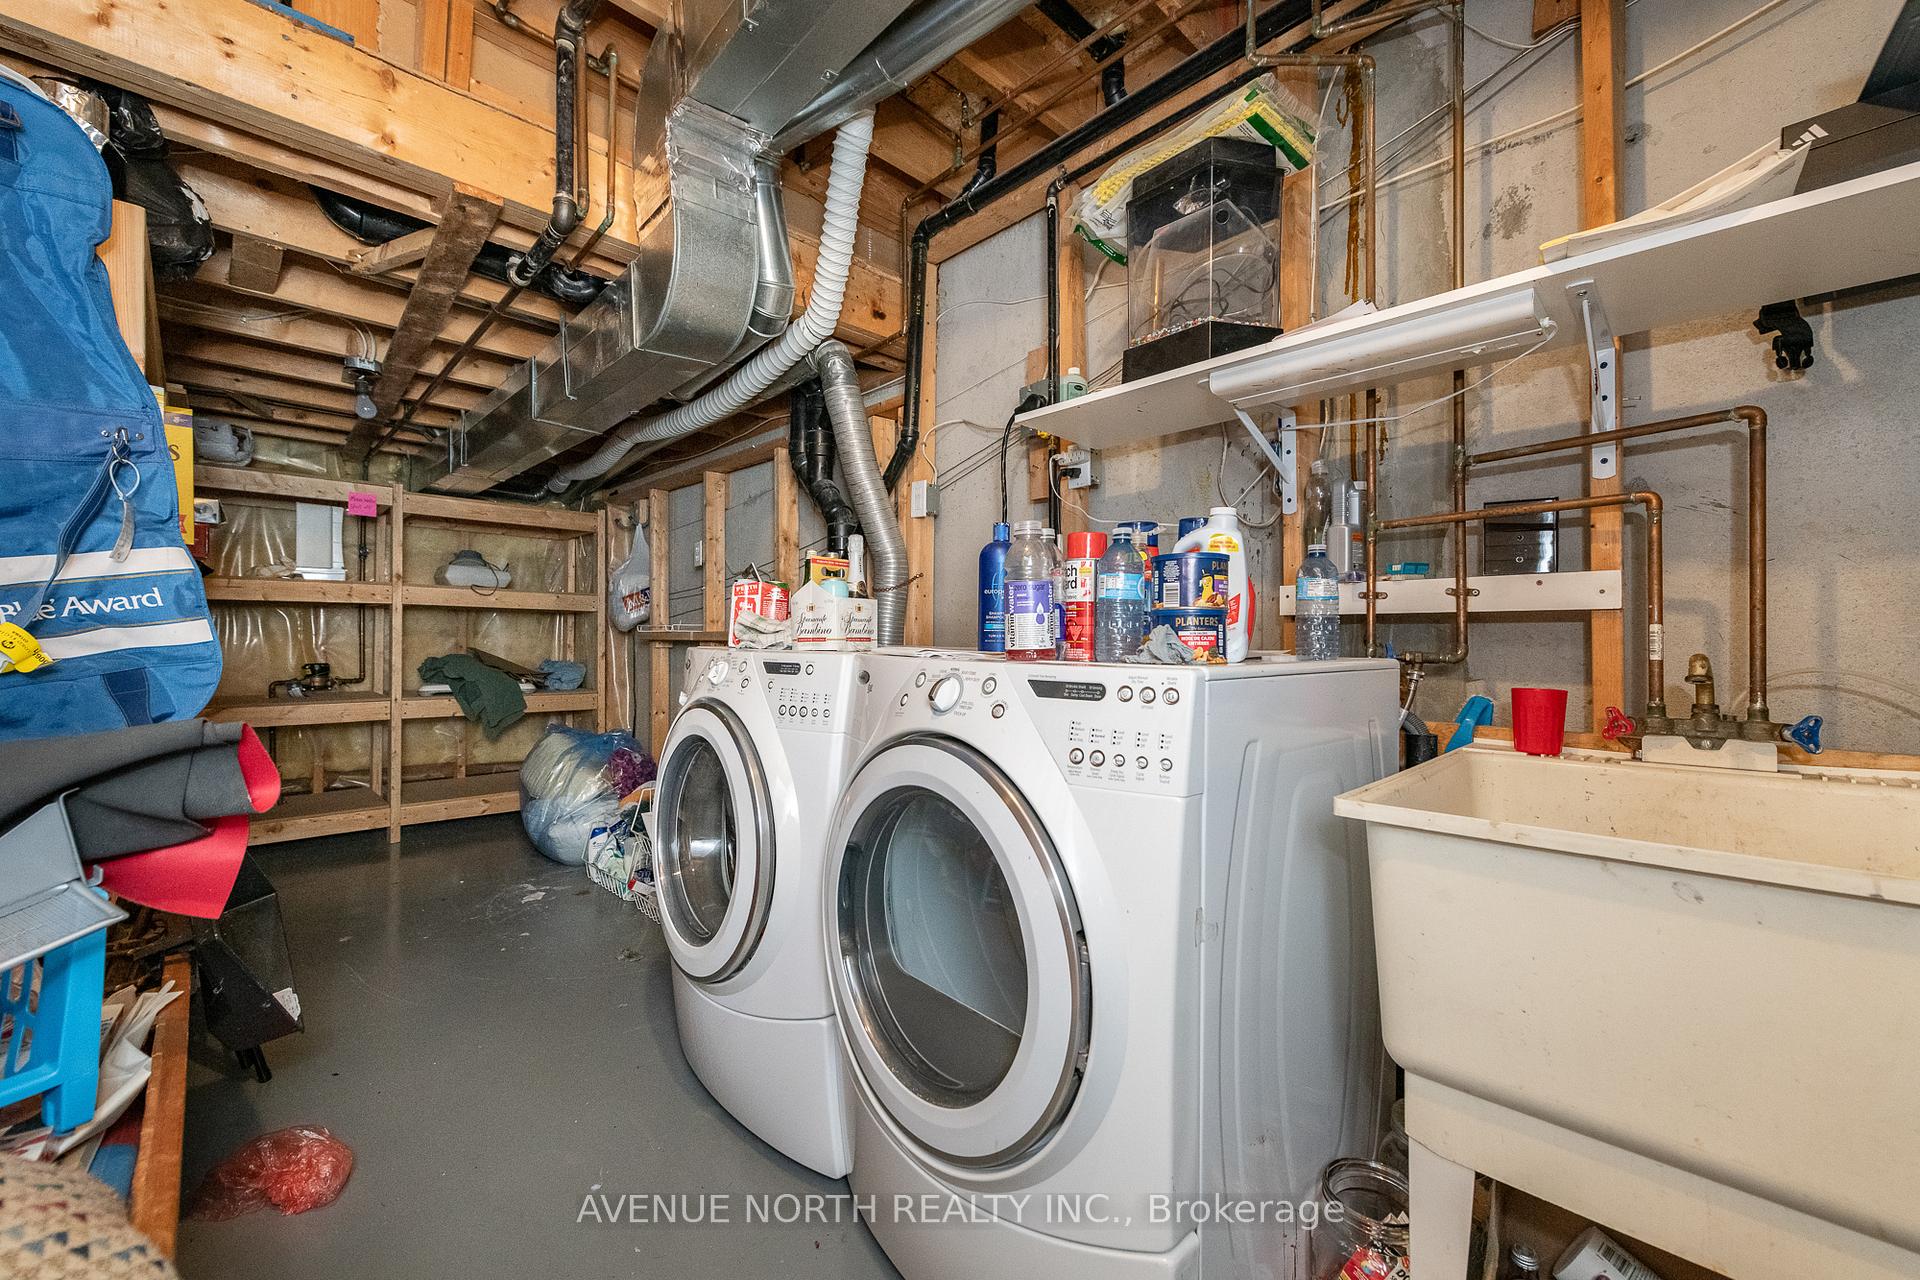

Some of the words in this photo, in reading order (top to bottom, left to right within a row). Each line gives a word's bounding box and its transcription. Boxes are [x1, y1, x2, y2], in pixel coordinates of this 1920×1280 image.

[62, 586, 164, 618] Award
[1008, 584, 1016, 648] vitaminwater
[1175, 616, 1219, 628] PLANTERS
[796, 623, 832, 636] Bambino
